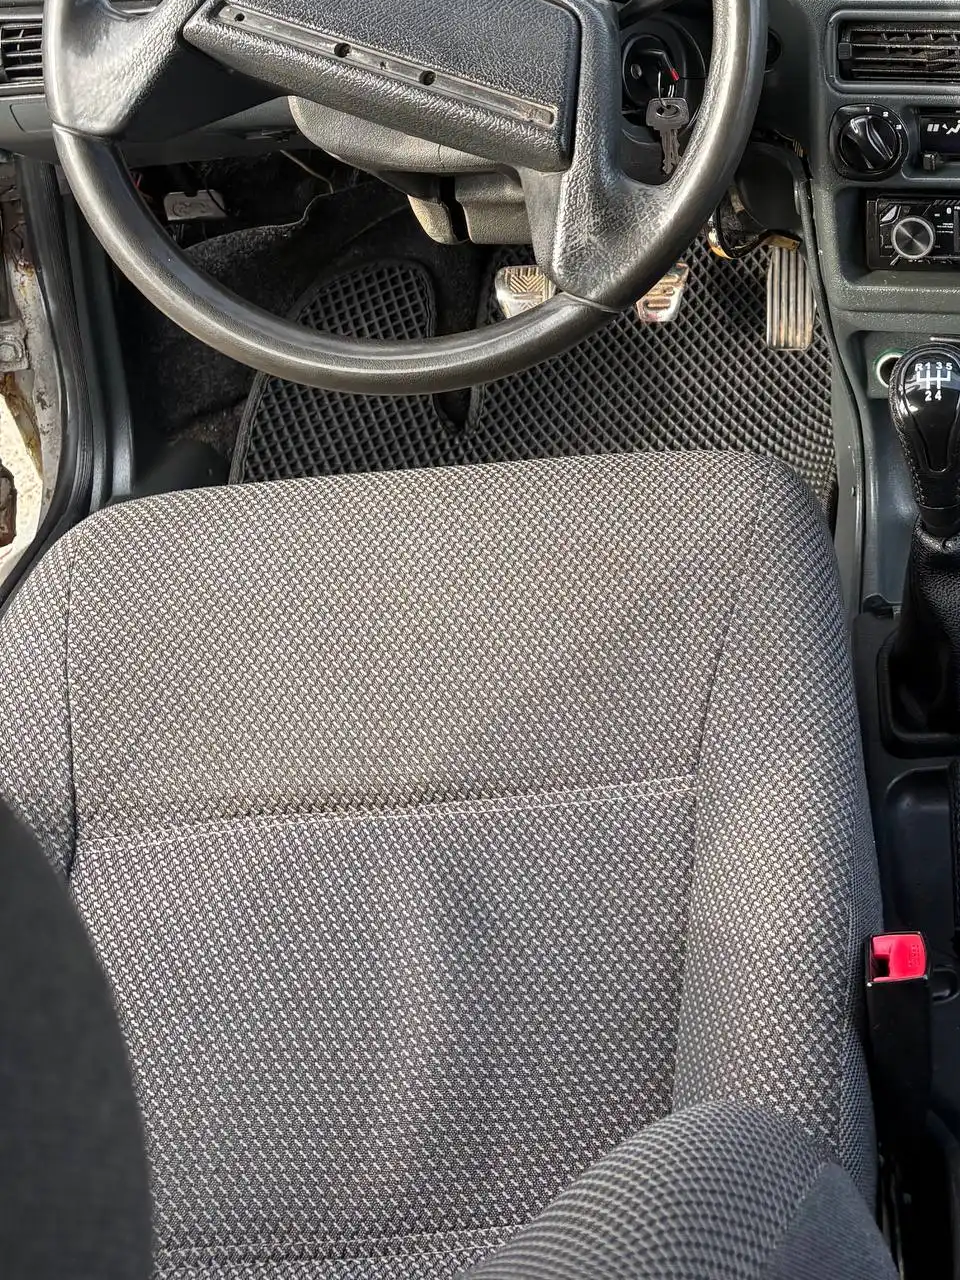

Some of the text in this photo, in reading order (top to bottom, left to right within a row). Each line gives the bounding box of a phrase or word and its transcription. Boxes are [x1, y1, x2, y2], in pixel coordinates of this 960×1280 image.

[915, 363, 923, 372] R
[936, 361, 943, 369] 3
[946, 362, 953, 370] 5
[925, 390, 942, 402] 2 4
